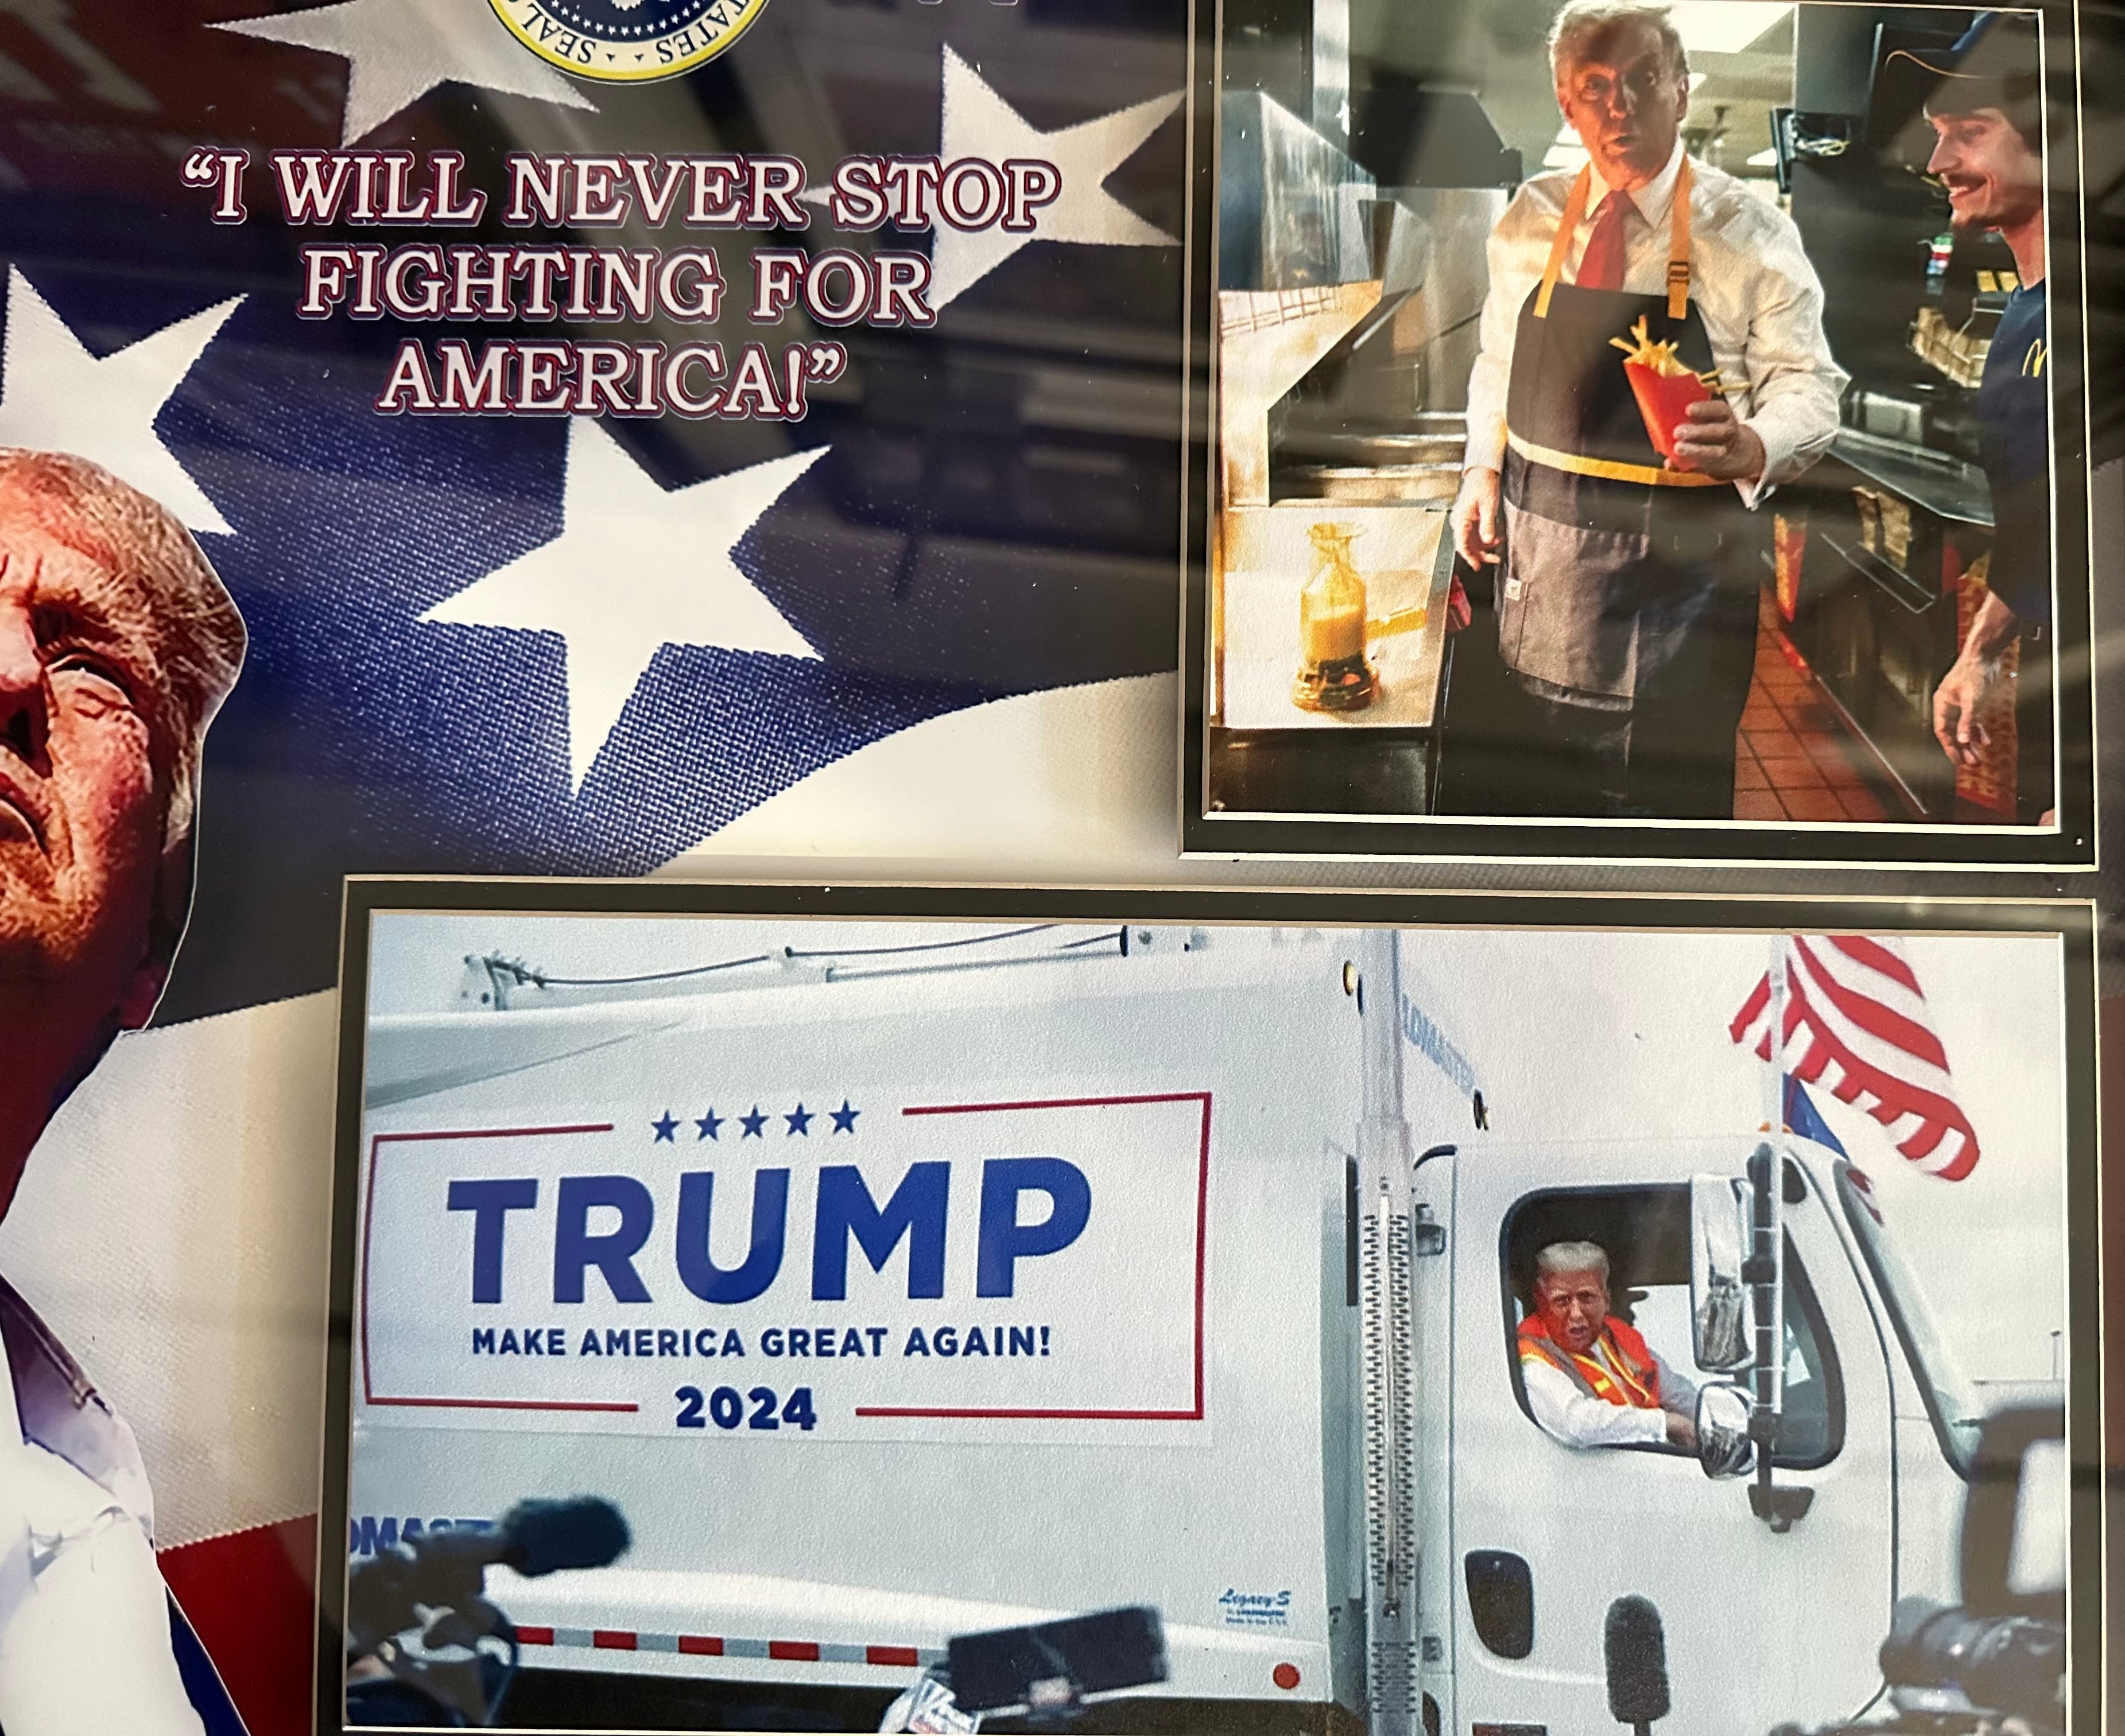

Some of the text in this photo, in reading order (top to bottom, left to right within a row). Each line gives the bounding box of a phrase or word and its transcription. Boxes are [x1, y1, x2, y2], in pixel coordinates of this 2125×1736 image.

[521, 3, 596, 64] SEAL
[276, 153, 484, 224] WILL
[507, 154, 808, 229] NEVER
[832, 158, 1060, 232] STOP
[297, 243, 935, 327] FIGHTING FOR
[448, 1158, 1091, 1304] TRUMP
[474, 1327, 1050, 1357] MAKE AMERICA GREAT AGAIN!
[676, 1386, 817, 1430] 2024
